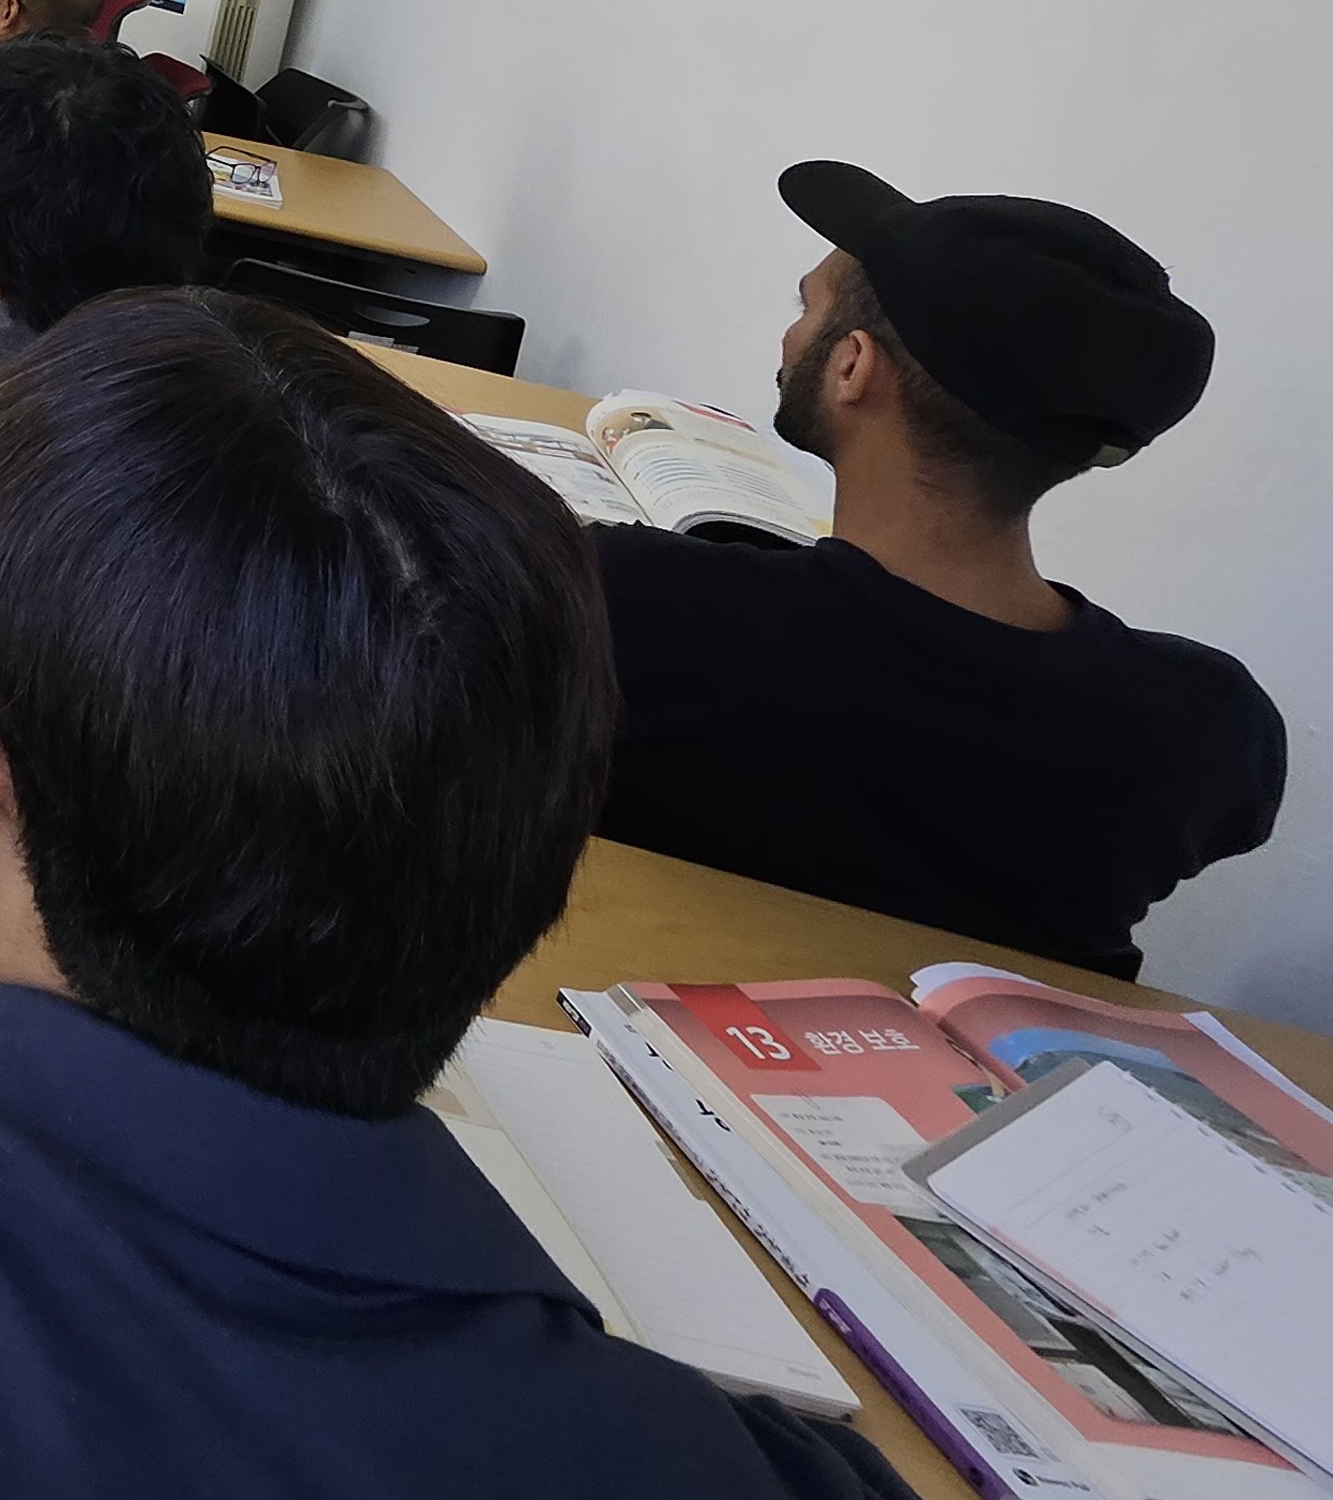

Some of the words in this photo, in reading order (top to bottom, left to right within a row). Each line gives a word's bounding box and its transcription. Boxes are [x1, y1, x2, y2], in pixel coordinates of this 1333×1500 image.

[726, 1026, 791, 1060] 13
[804, 1030, 865, 1055] 환경
[859, 1028, 921, 1050] 보호
